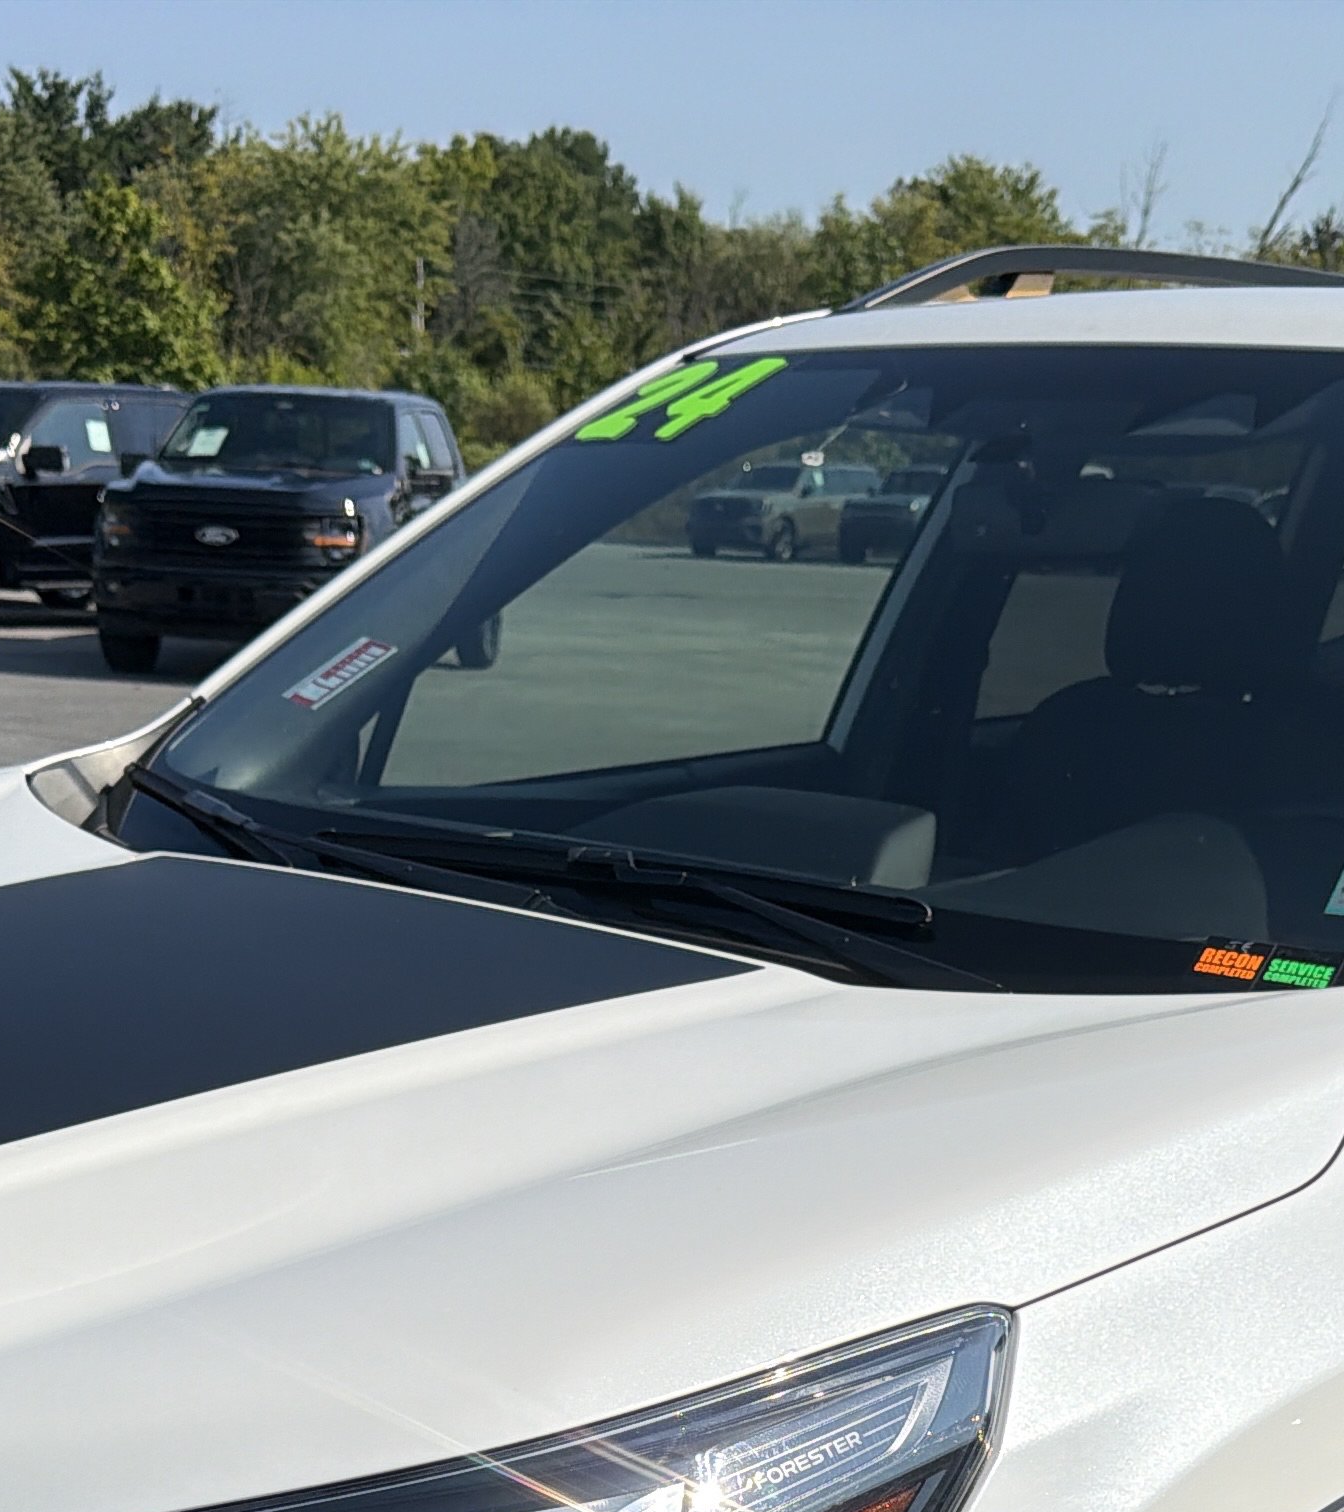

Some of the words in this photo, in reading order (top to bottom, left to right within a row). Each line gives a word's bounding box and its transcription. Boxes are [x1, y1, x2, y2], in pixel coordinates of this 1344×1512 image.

[575, 357, 789, 441] 24
[1199, 947, 1265, 971] RECON
[1268, 958, 1336, 980] SERVICE
[1193, 962, 1256, 981] COMPLETED
[753, 1431, 862, 1490] FORESTER
